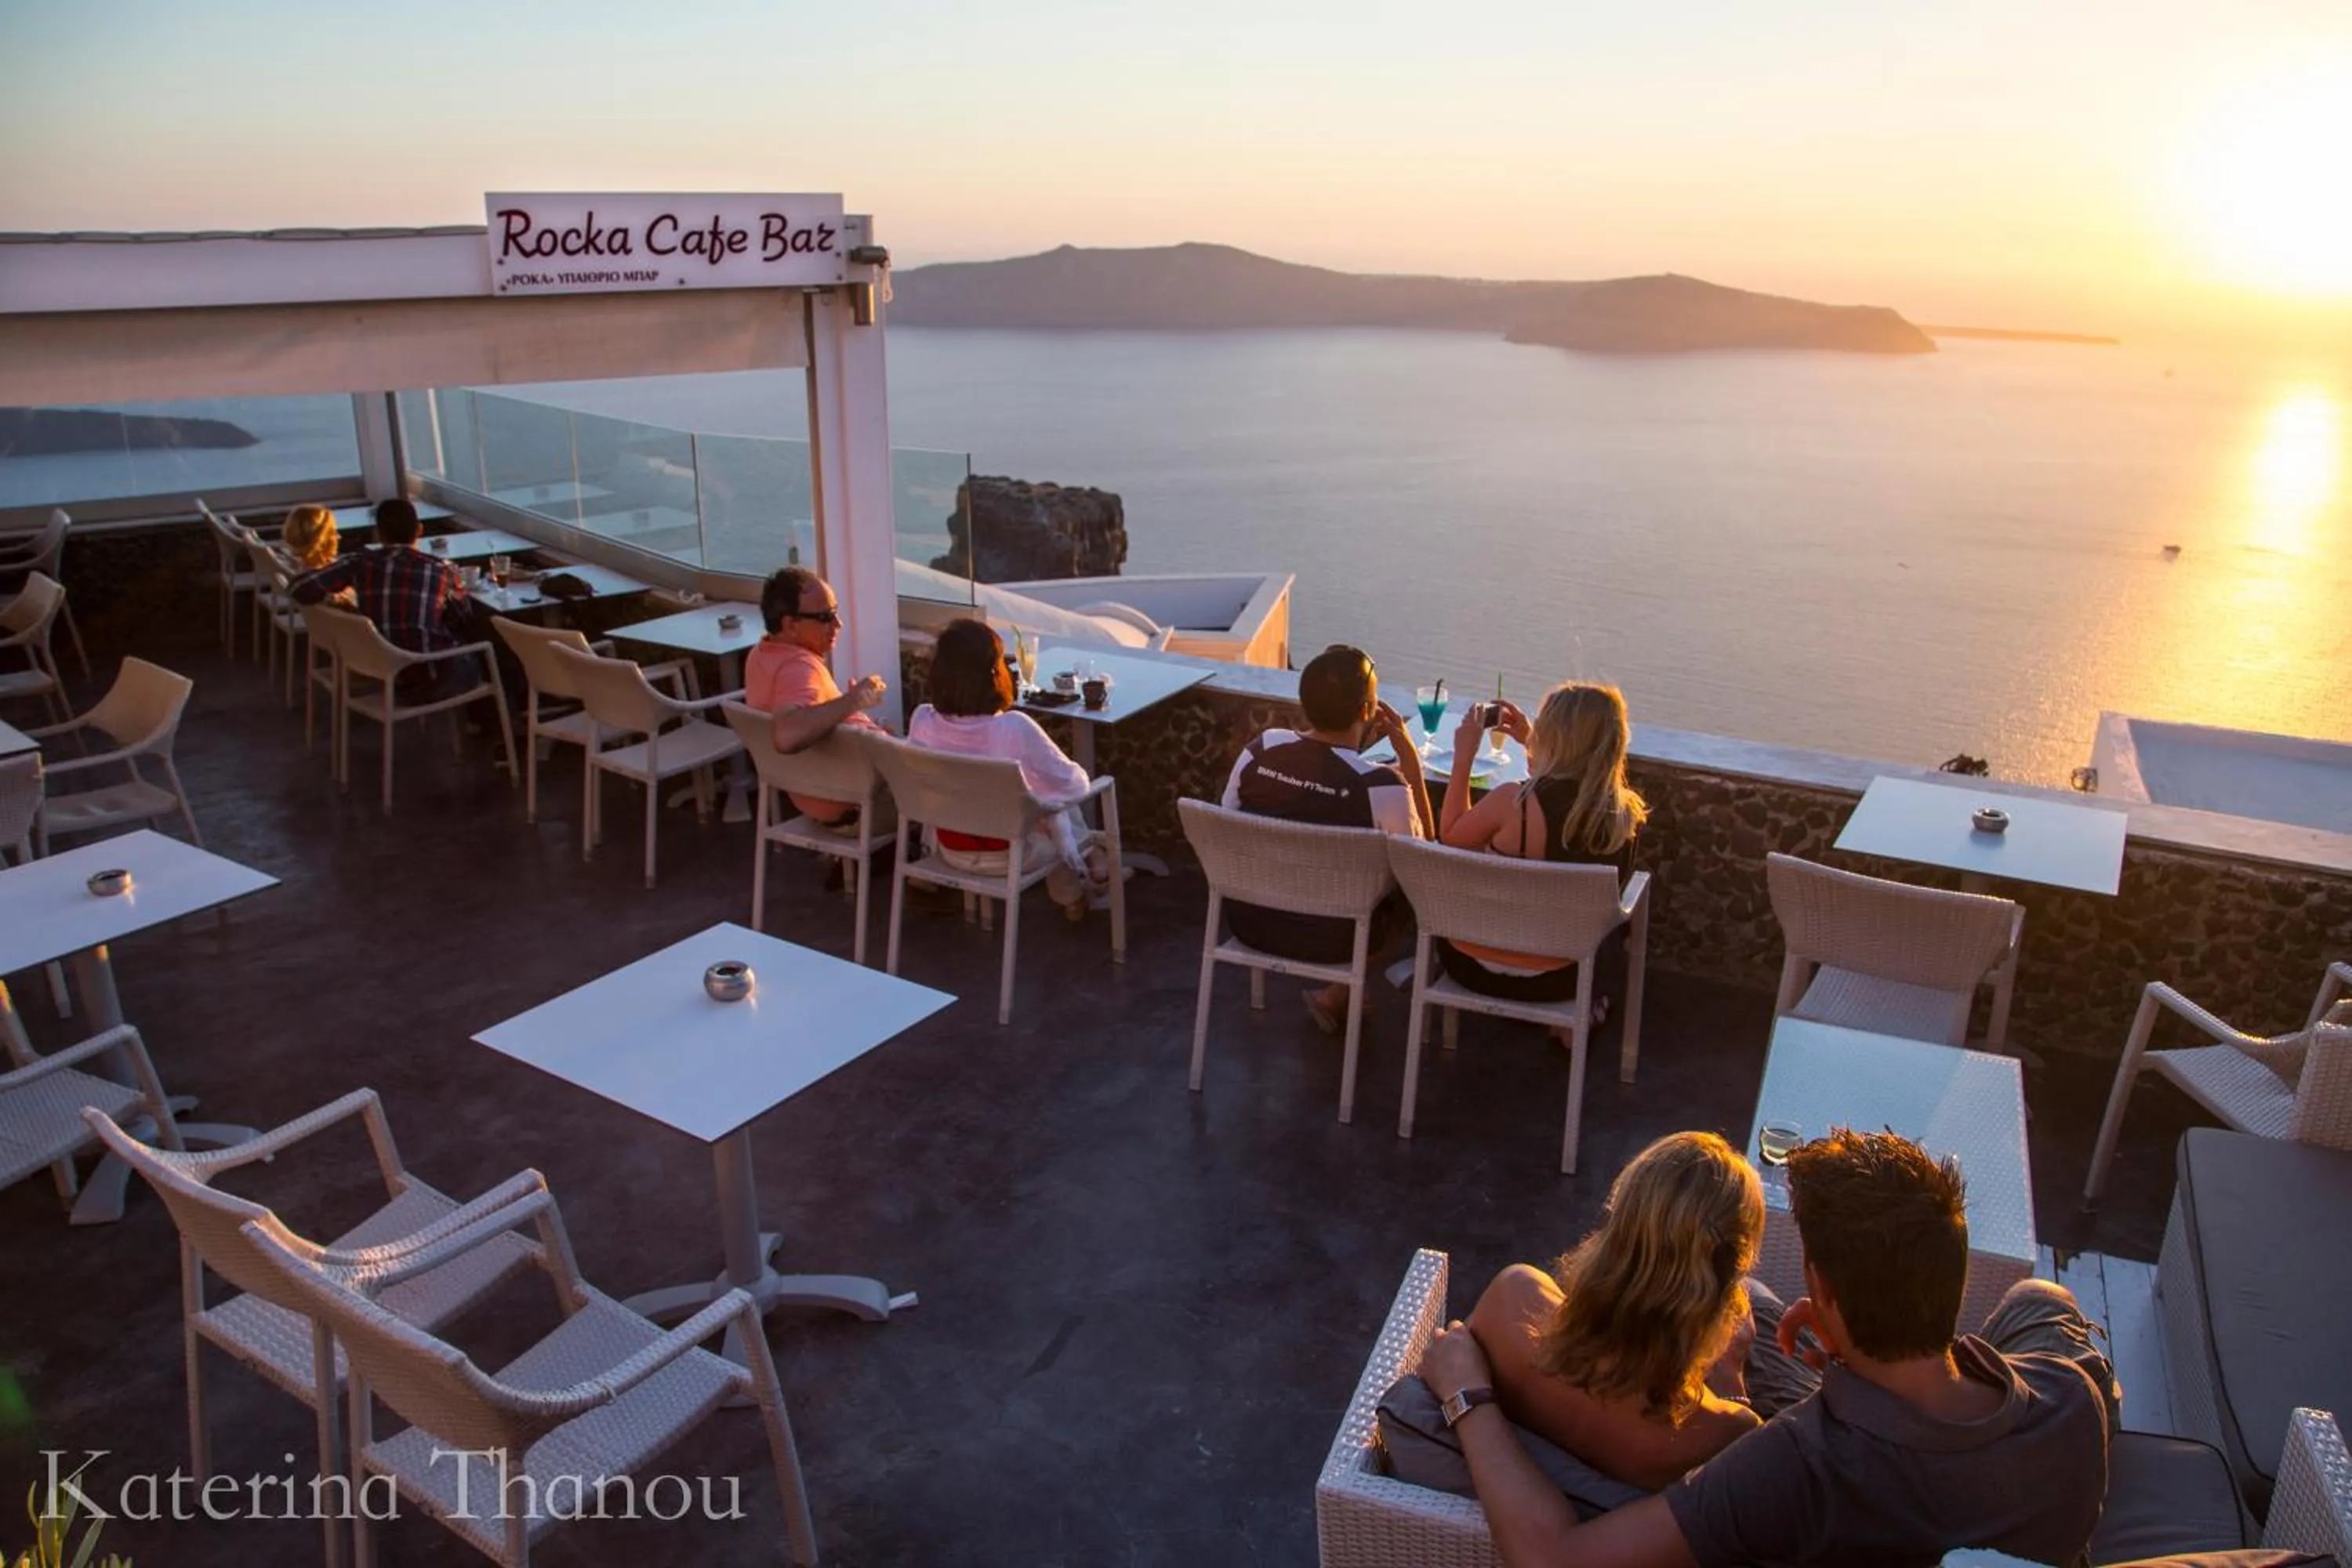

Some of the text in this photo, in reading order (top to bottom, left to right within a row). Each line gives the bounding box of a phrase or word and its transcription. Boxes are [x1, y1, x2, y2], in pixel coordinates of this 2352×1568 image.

[496, 209, 837, 265] Rocka Cafe Bar
[1257, 766, 1277, 779] BMW
[1276, 772, 1303, 787] Sauber
[1315, 783, 1336, 795] Team
